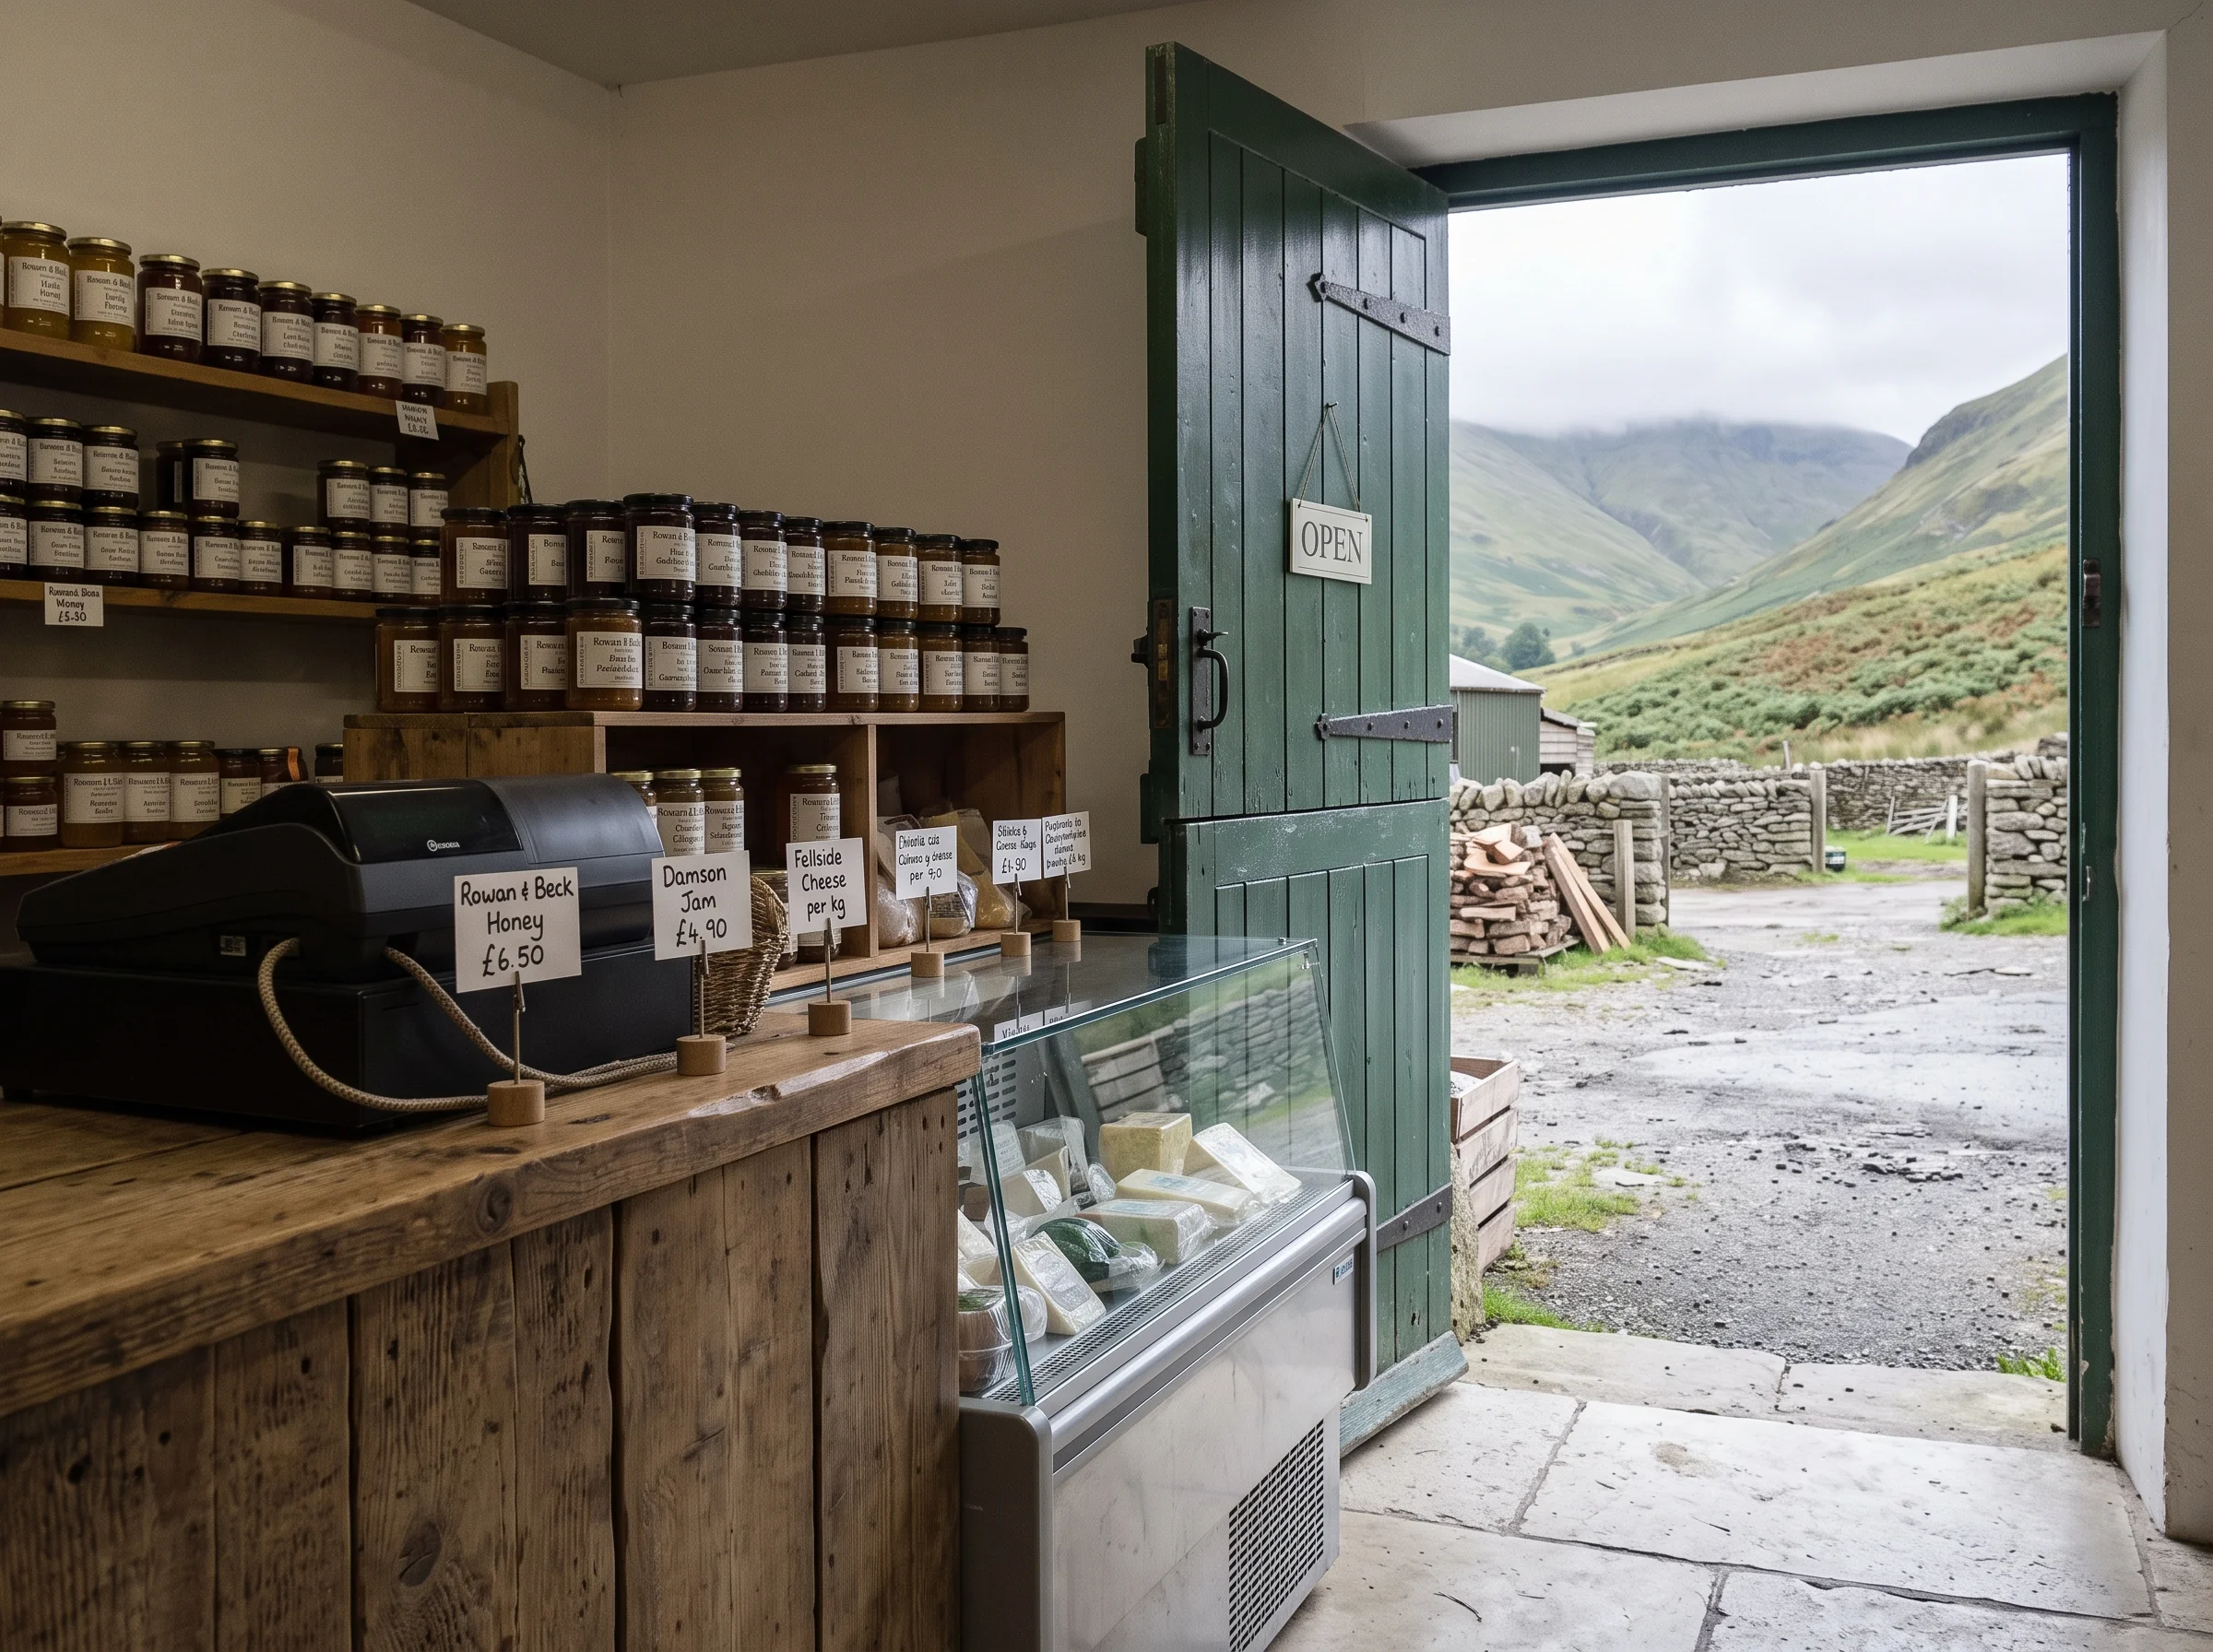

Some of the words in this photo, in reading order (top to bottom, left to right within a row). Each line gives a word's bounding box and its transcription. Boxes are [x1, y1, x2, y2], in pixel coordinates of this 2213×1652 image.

[1301, 521, 1363, 565] OPEN
[593, 638, 621, 646] Rowan
[795, 848, 843, 868] Fellside
[662, 865, 727, 888] Damson
[802, 874, 846, 892] Cheese
[909, 872, 924, 885] per
[461, 881, 516, 906] Rowan
[521, 881, 529, 901] &
[535, 876, 574, 900] Beck
[680, 889, 716, 914] Jam
[808, 903, 826, 922] per
[831, 896, 846, 920] kg
[487, 911, 544, 942] Honey
[676, 918, 728, 948] £4.90
[483, 944, 544, 977] £6.50
